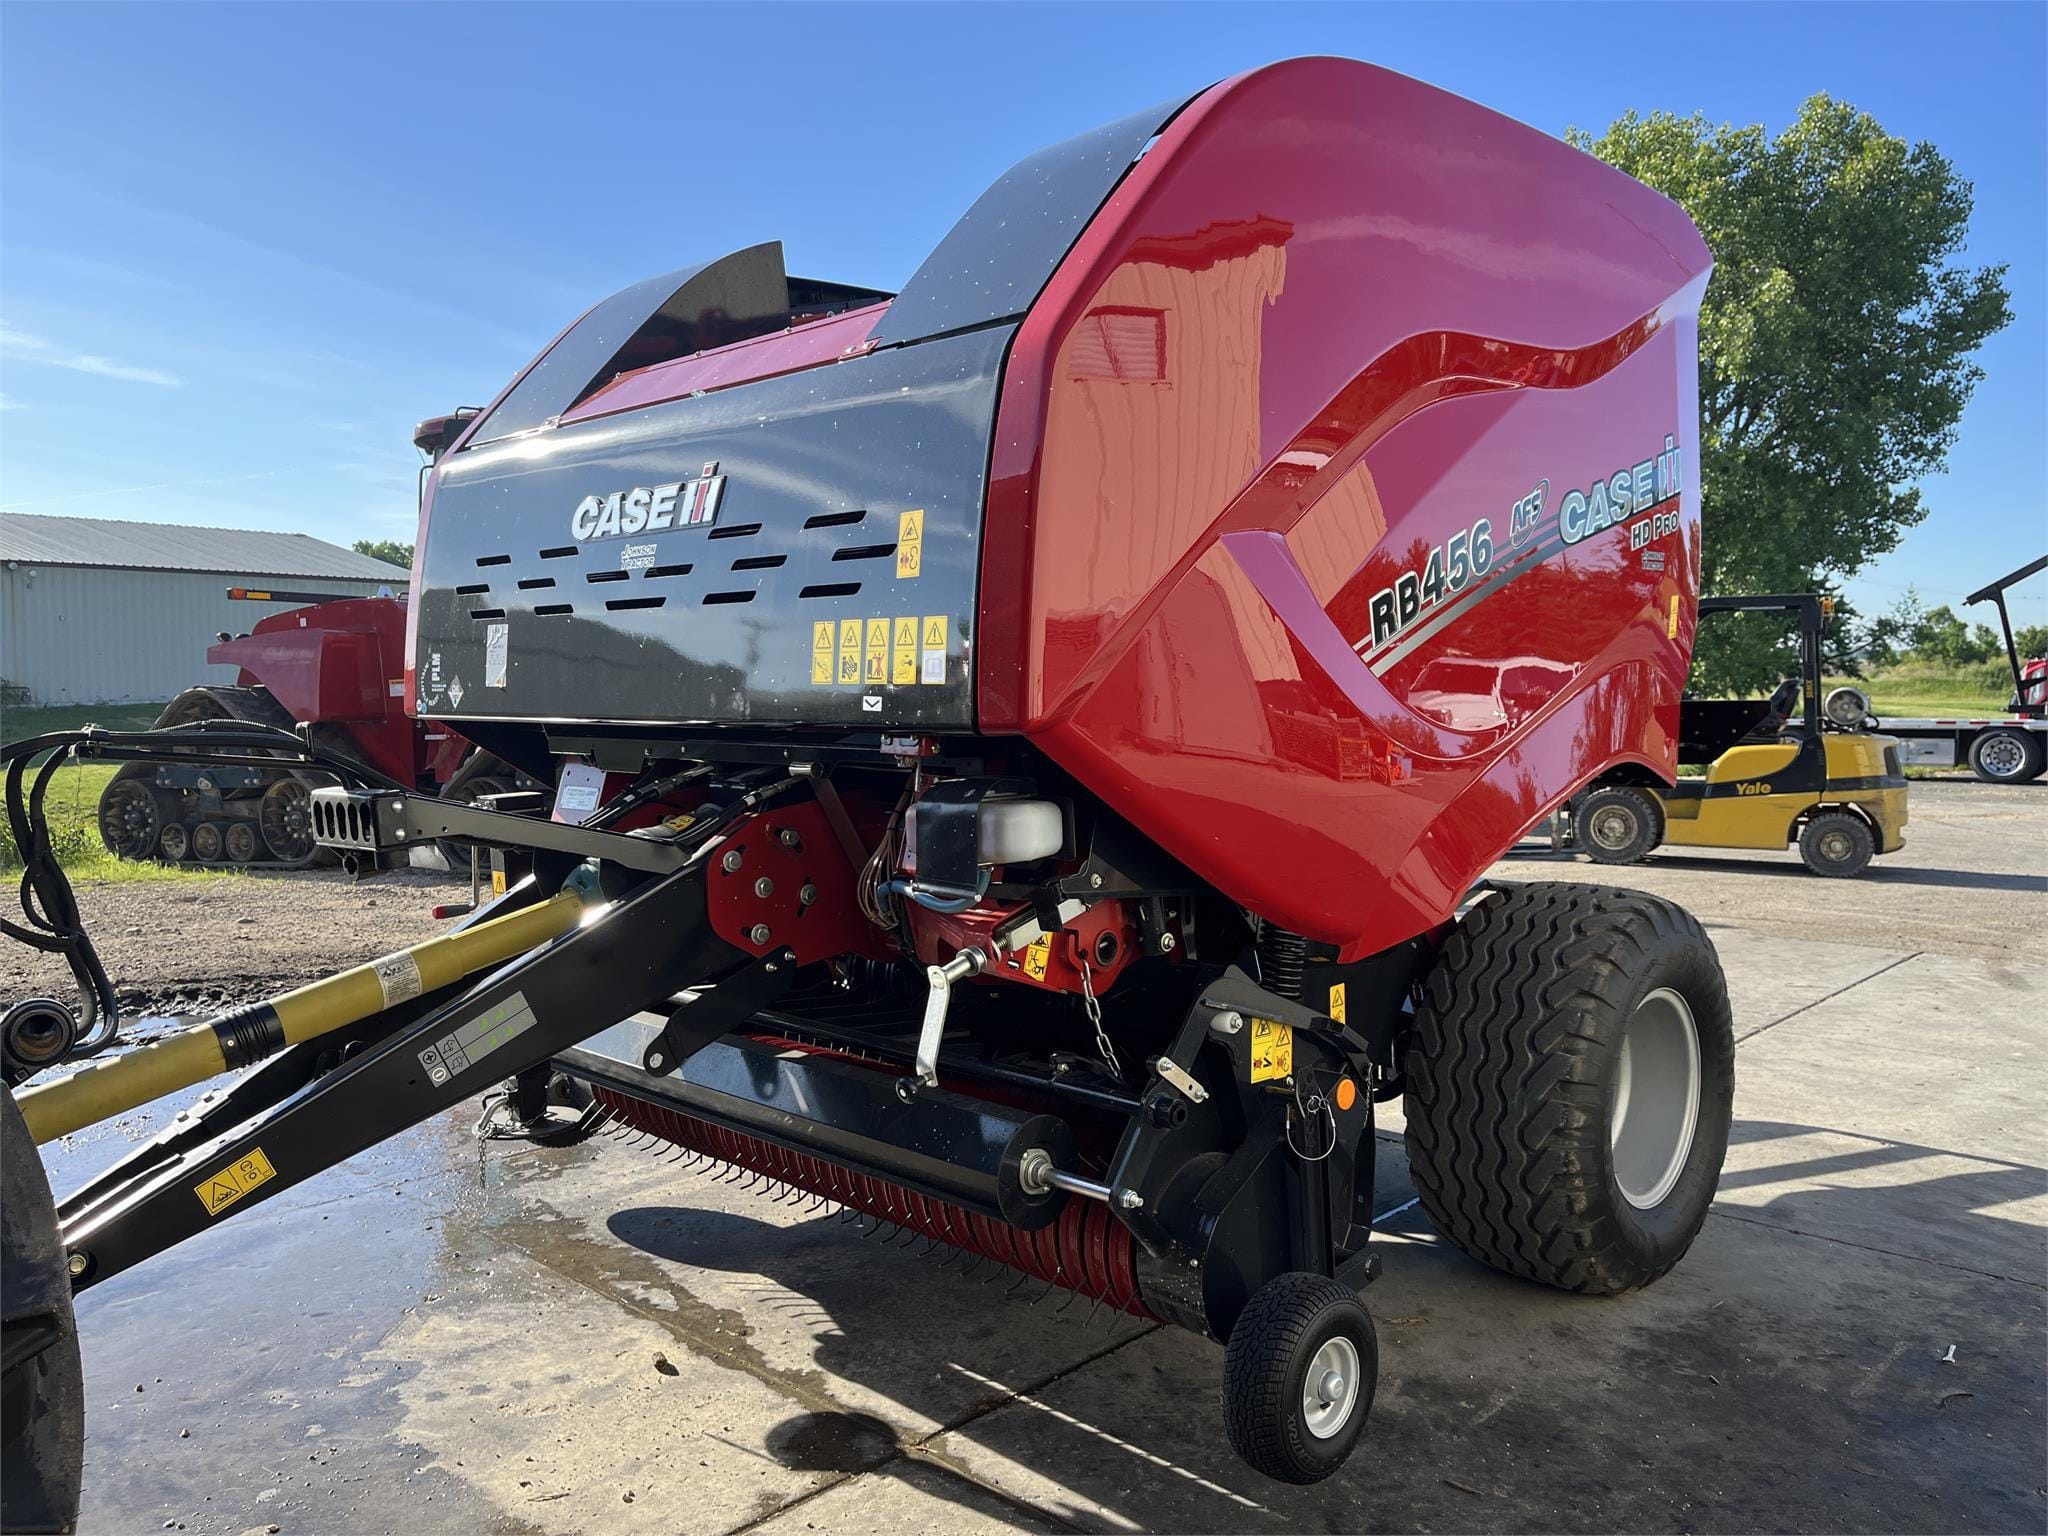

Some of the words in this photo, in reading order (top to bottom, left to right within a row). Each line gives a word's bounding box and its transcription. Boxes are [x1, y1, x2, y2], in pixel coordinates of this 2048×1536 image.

[571, 482, 686, 543] CASE
[1509, 489, 1542, 538] AFS
[1559, 459, 1653, 545] CASE
[621, 544, 657, 557] JOHNSON
[1631, 519, 1653, 552] HD
[620, 556, 656, 570] TRACTOR
[1368, 518, 1494, 651] RB456
[431, 653, 441, 682] PLM
[1736, 781, 1772, 796] Yale
